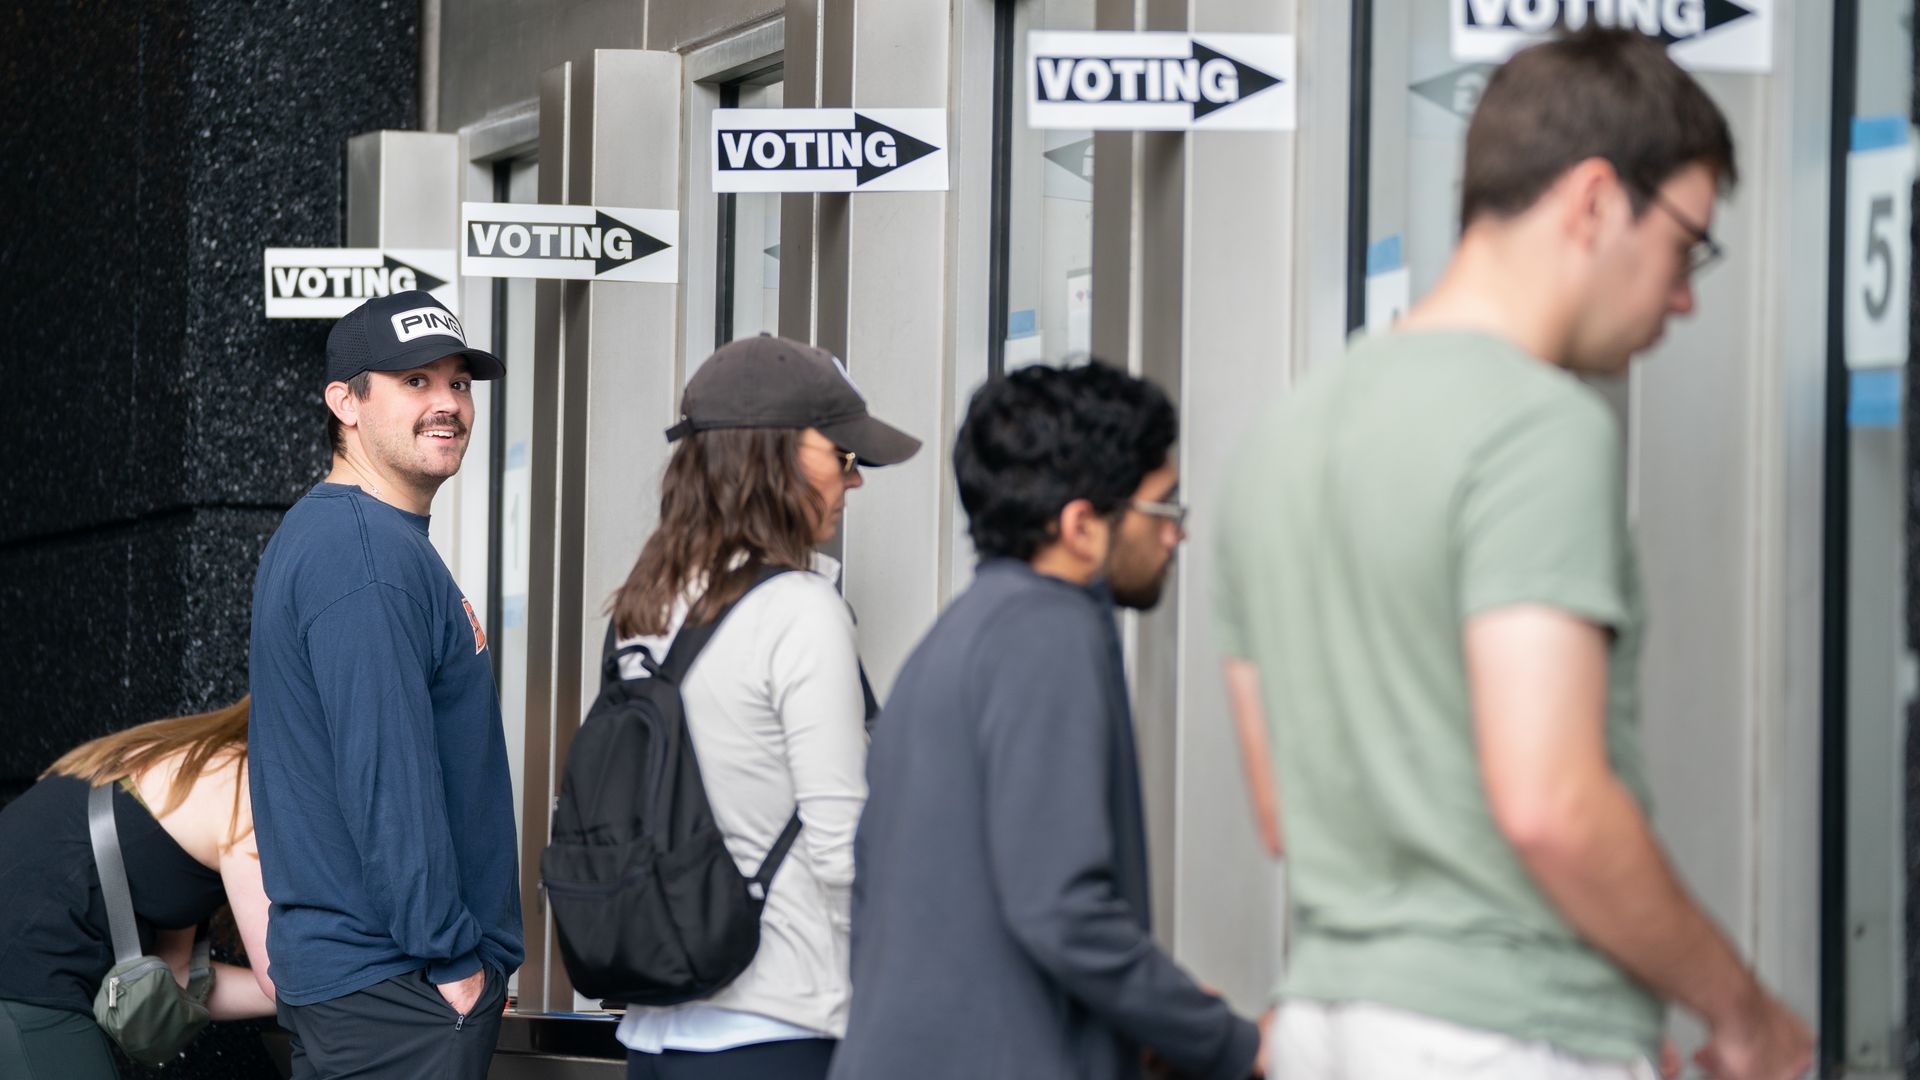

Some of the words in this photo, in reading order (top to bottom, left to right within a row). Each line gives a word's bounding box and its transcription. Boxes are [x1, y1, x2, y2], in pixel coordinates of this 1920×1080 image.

[1037, 59, 1240, 103] VOTING
[721, 132, 897, 168] VOTING
[471, 223, 632, 260] VOTING
[1863, 197, 1893, 321] 5
[273, 267, 417, 297] VOTING
[401, 313, 461, 335] PING
